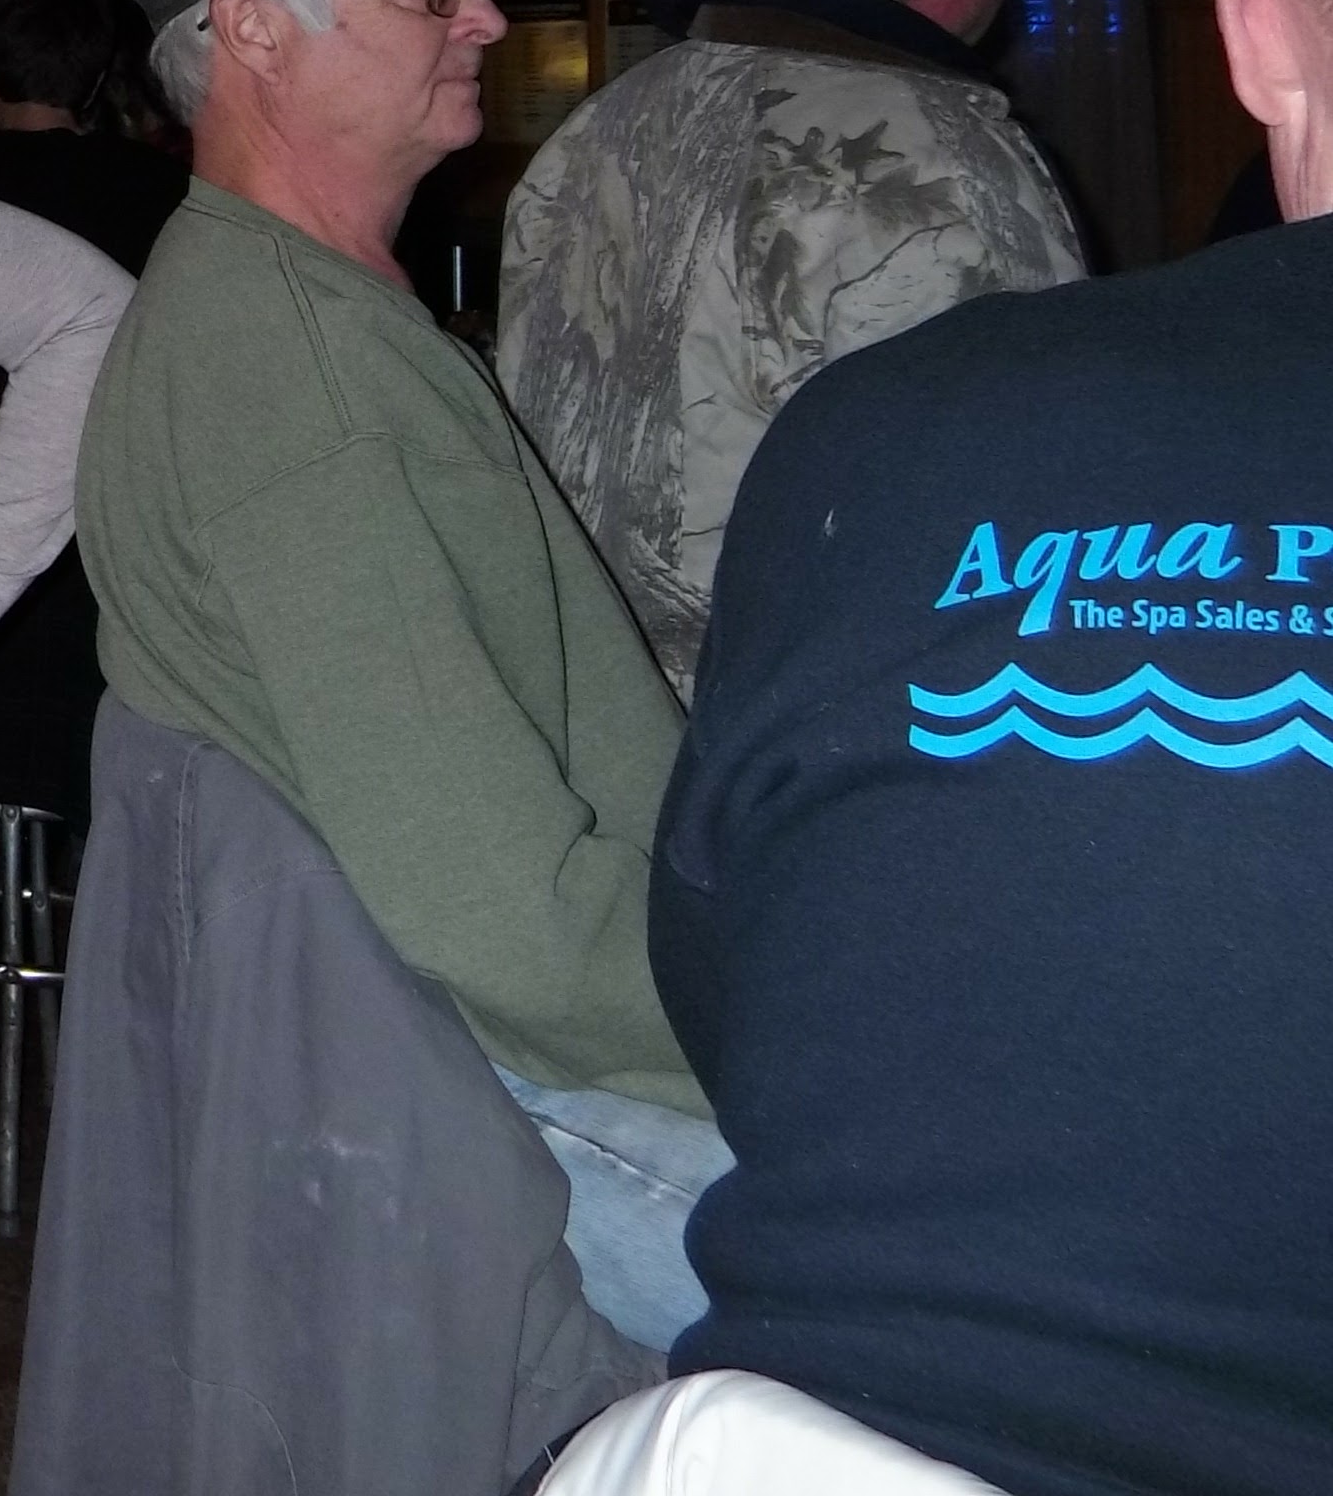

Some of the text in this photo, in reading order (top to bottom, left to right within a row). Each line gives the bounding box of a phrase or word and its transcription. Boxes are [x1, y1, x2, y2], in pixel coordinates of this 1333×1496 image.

[934, 521, 1333, 637] Aqua P
[1069, 599, 1123, 629] The
[1132, 600, 1186, 634] Spa
[1195, 600, 1279, 632] Sales
[1288, 604, 1314, 634] &
